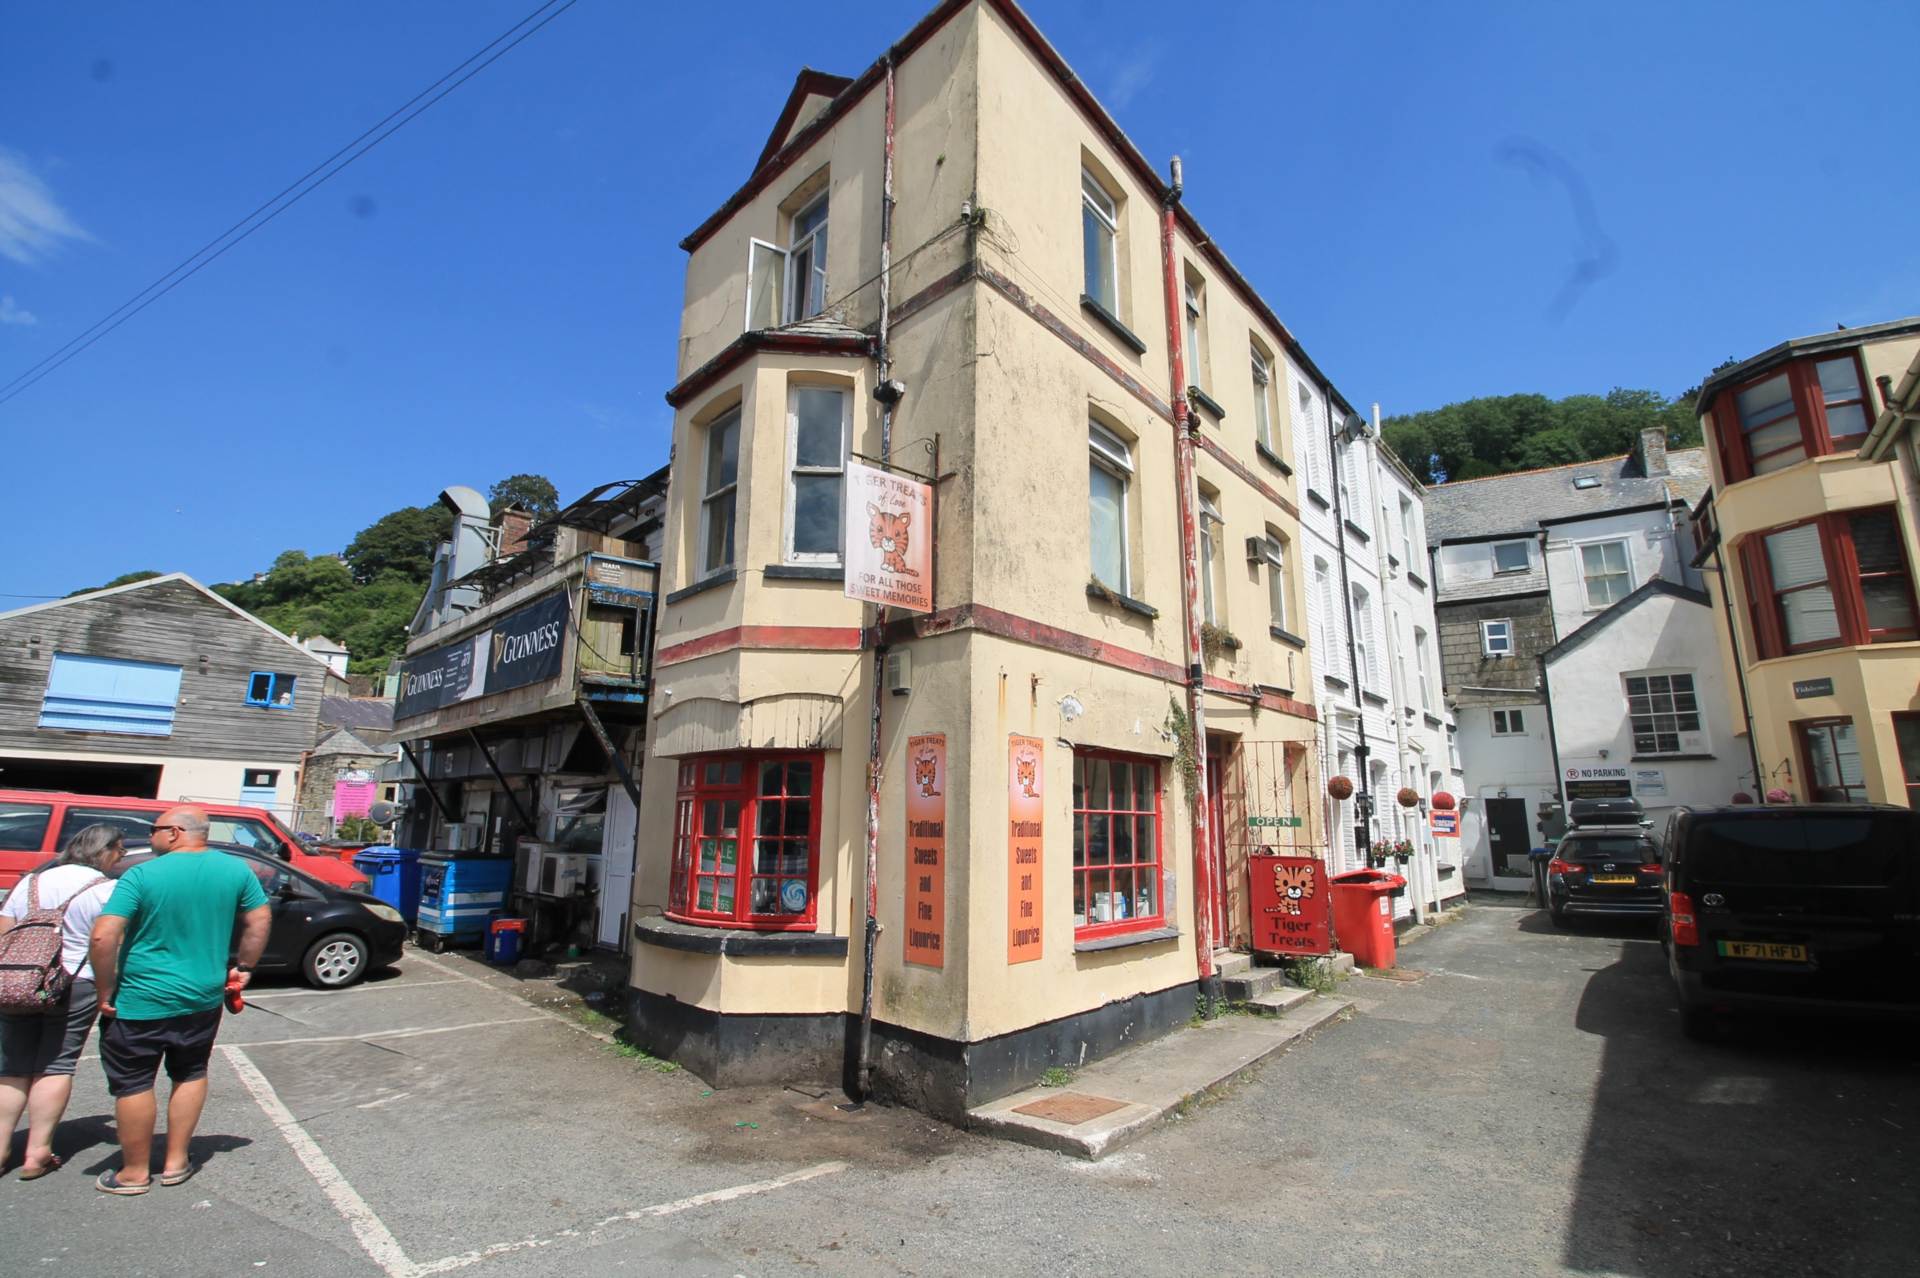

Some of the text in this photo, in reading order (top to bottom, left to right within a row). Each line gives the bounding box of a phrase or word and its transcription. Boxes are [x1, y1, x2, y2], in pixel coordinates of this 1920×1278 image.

[853, 473, 887, 489] TGER
[858, 571, 922, 595] FOR ALL THOSE
[849, 583, 929, 608] SWEET MEMORIES
[503, 621, 560, 664] GUINNESS
[407, 667, 444, 697] GUINNESS
[1581, 767, 1626, 778] NO PARKING
[909, 819, 944, 838] Traditional
[1011, 820, 1042, 838] Traditional
[1256, 817, 1291, 827] OPEN
[914, 847, 938, 866] Sweets
[1016, 847, 1037, 864] Sweets
[919, 875, 931, 893] and
[1020, 874, 1032, 891] and
[918, 901, 932, 921] Fine
[1020, 900, 1032, 918] Fine
[1271, 916, 1312, 933] Tiger
[909, 930, 940, 950] Liquorice
[1013, 928, 1040, 947] Liquorice
[1268, 932, 1316, 948] Treats
[1731, 943, 1801, 959] WF71 HFD
